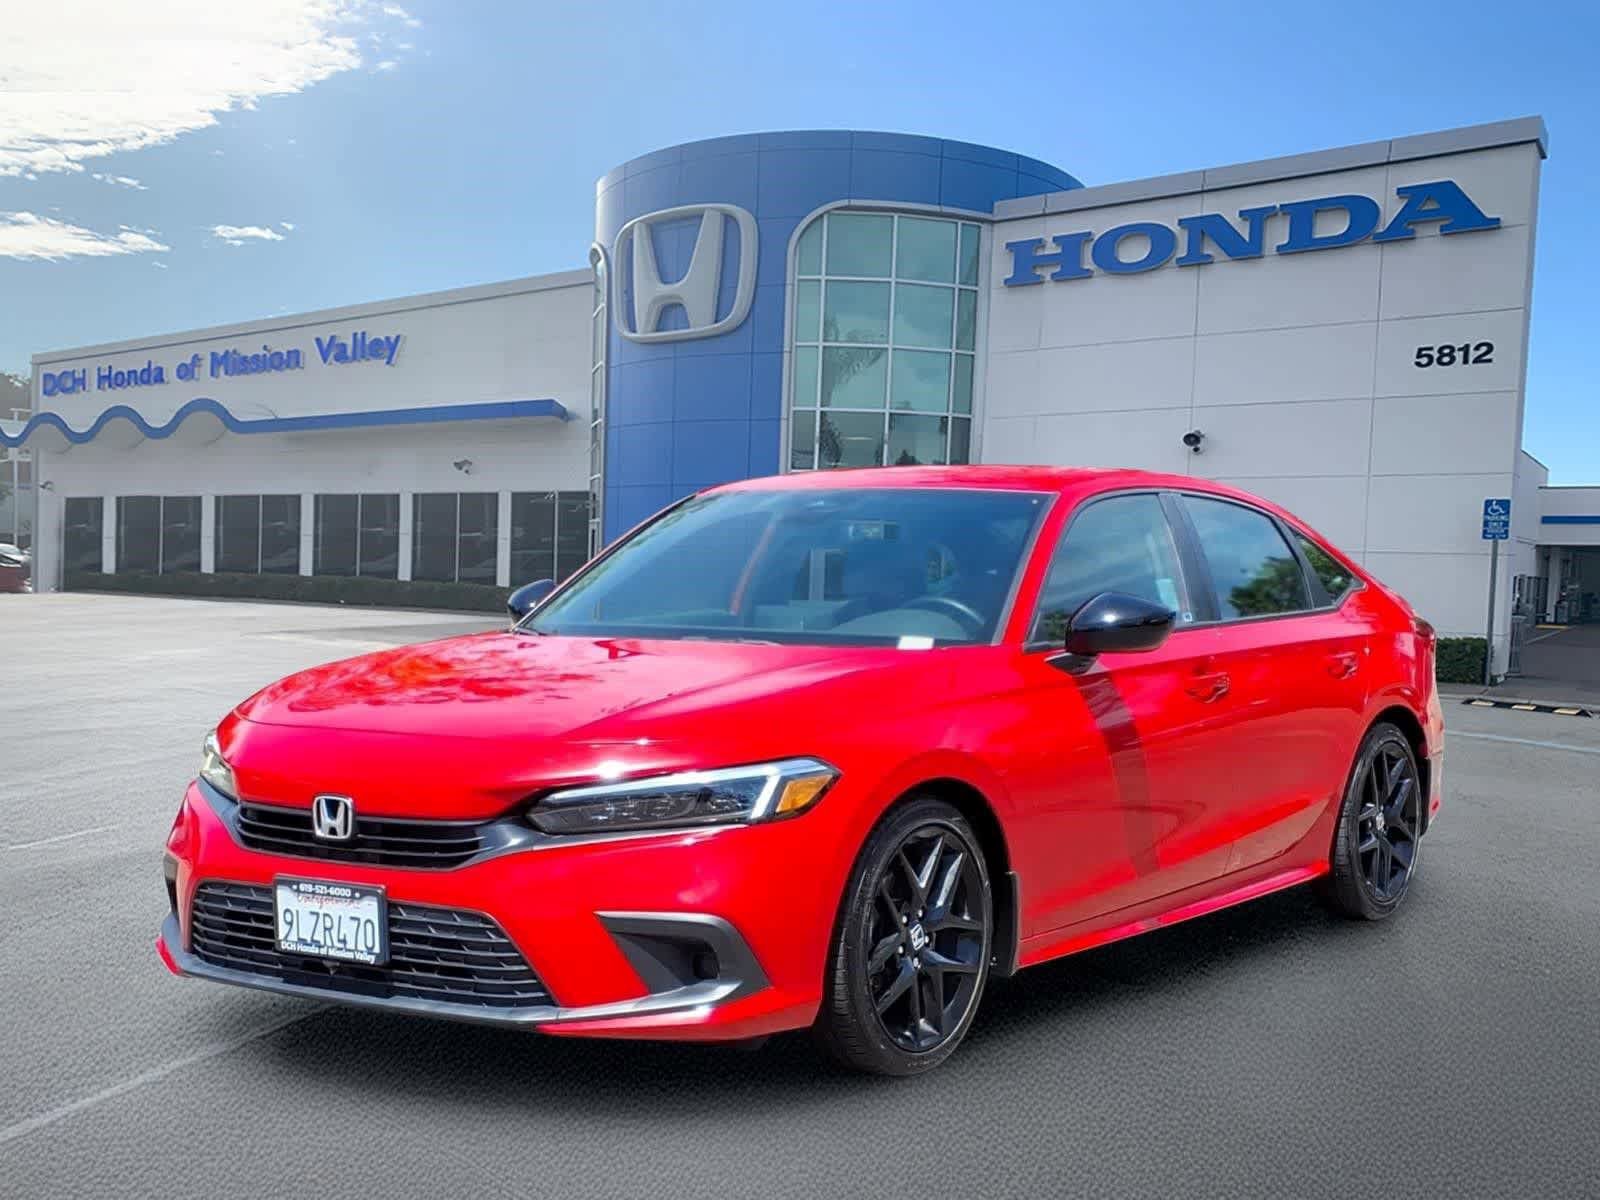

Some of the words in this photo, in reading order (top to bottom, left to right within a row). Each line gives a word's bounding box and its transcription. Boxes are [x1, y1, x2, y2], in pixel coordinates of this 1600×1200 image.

[1003, 180, 1502, 287] HONDA
[42, 366, 87, 397] DCH
[96, 359, 165, 390] Honda
[175, 353, 203, 382] of
[209, 344, 303, 379] Mission
[315, 331, 402, 367] Valley
[1413, 341, 1495, 369] 5812
[282, 907, 376, 951] 9LZR470
